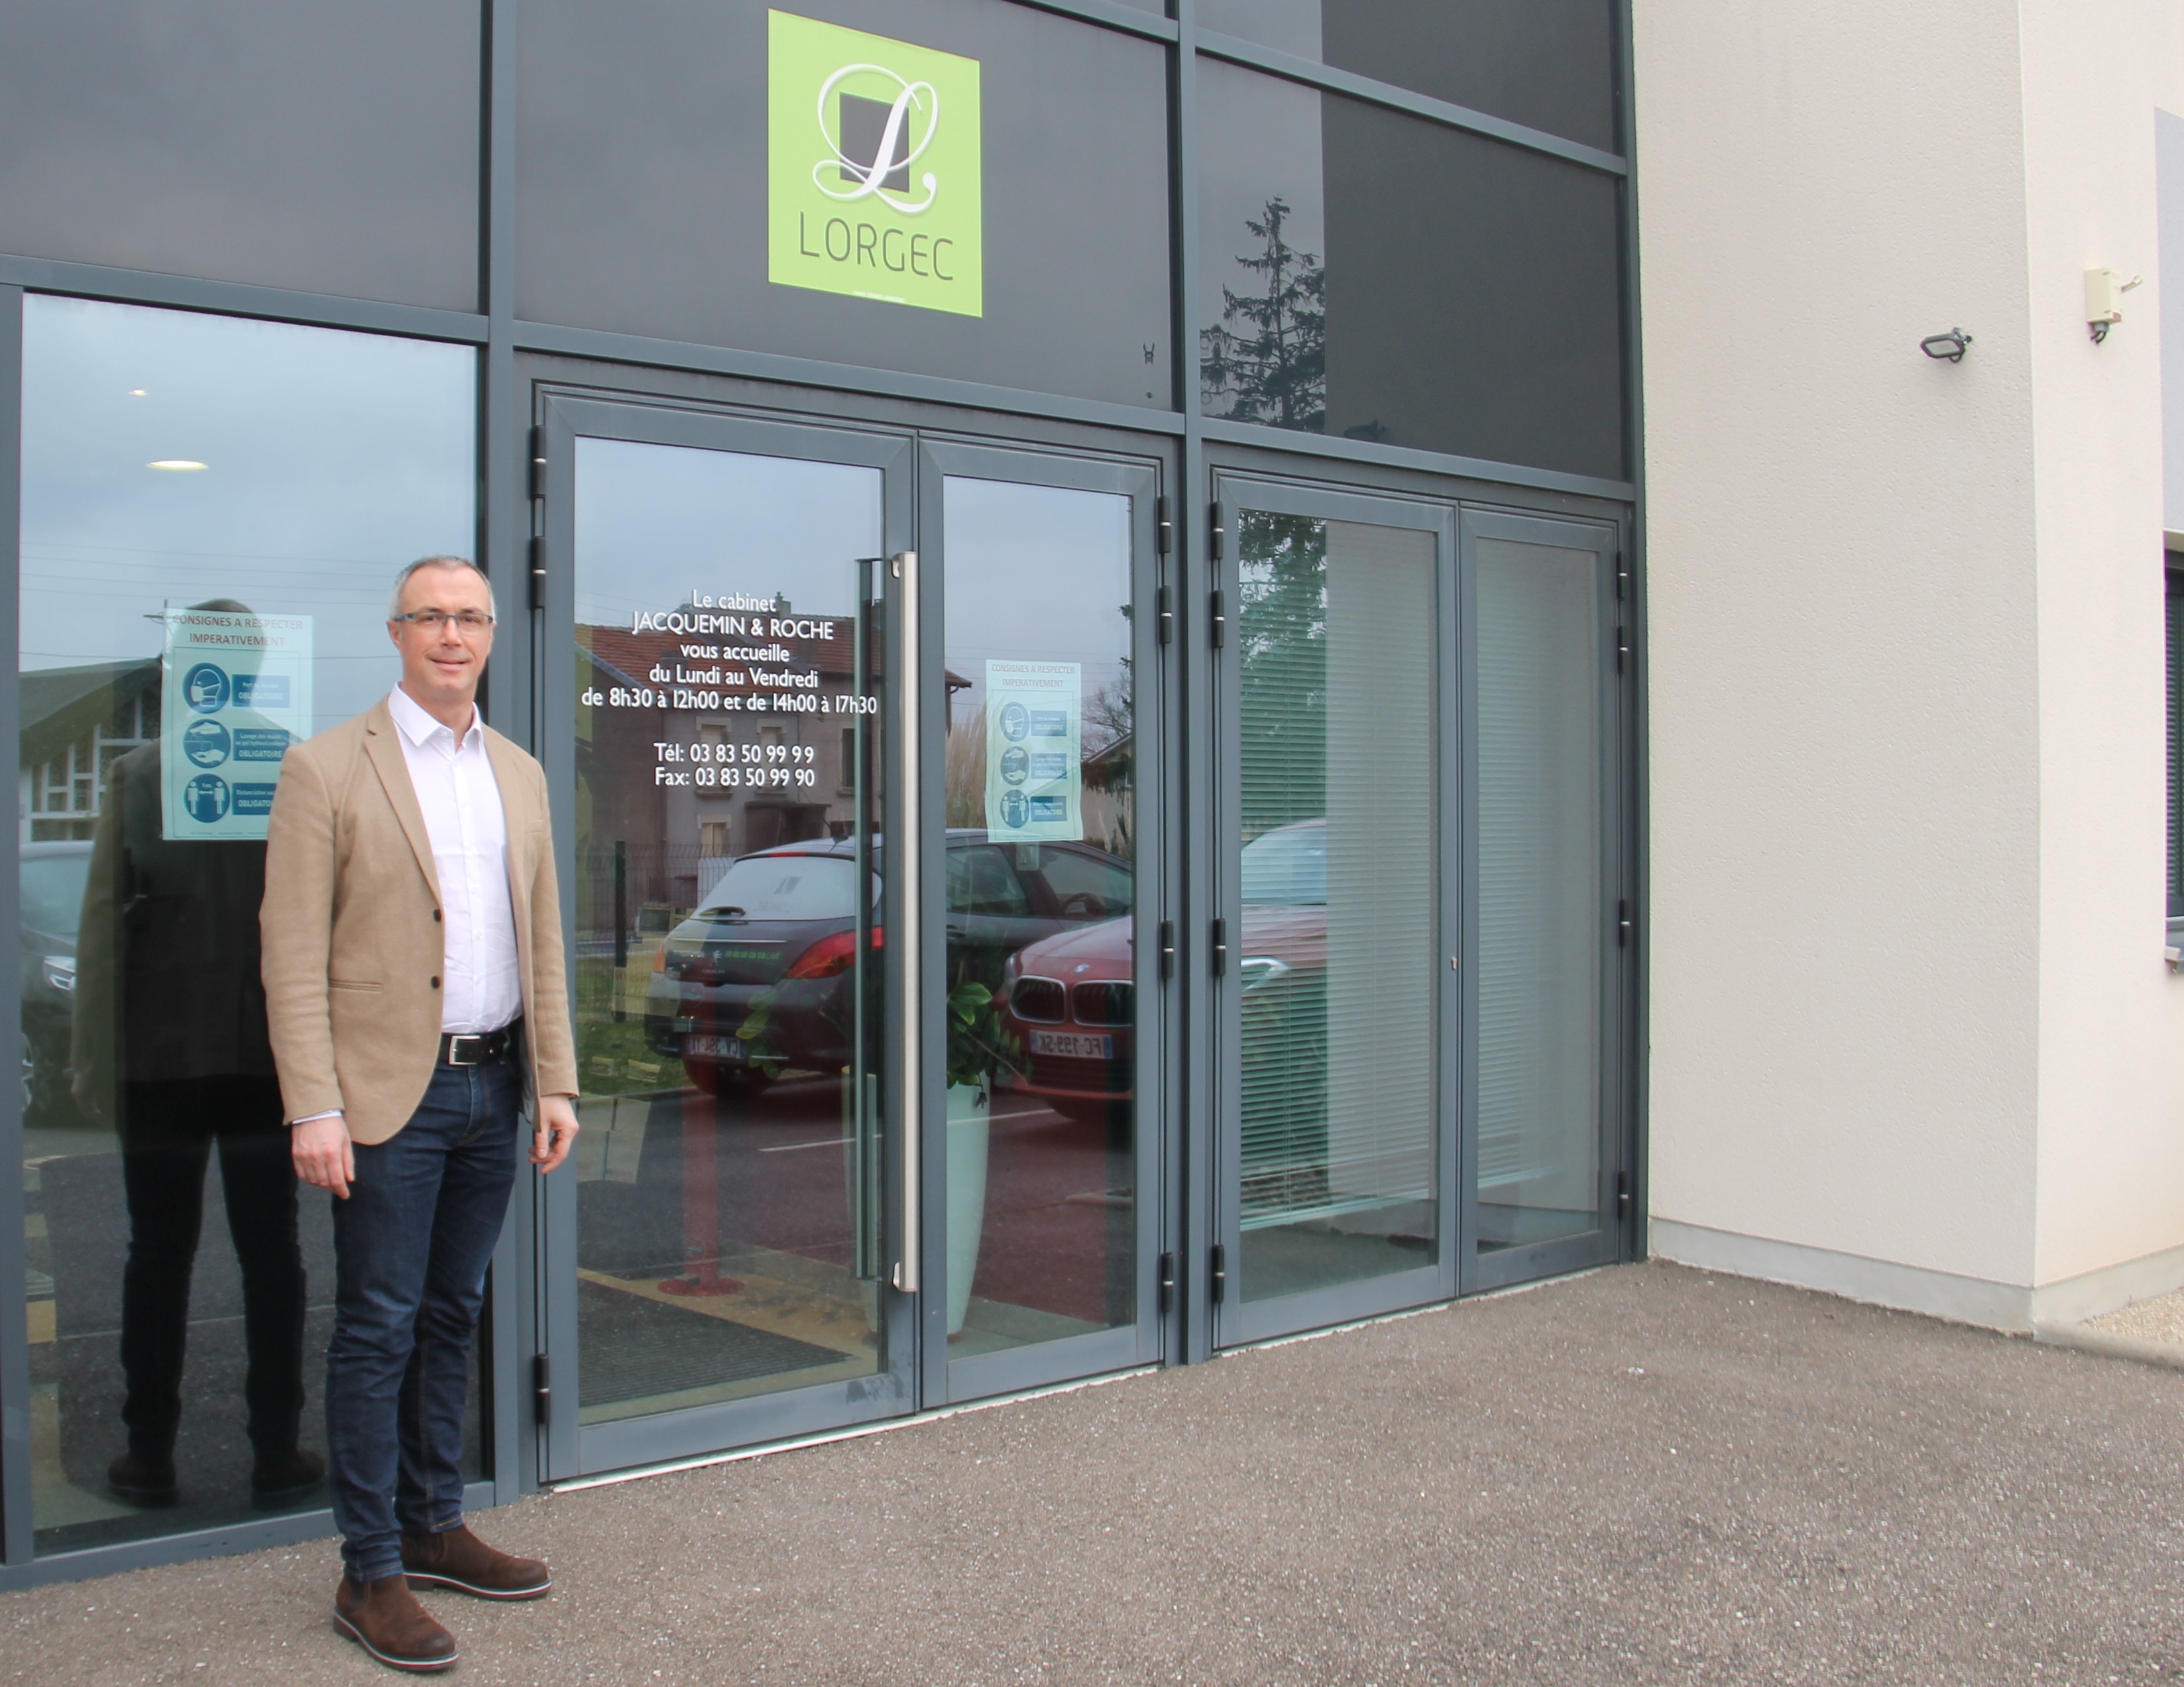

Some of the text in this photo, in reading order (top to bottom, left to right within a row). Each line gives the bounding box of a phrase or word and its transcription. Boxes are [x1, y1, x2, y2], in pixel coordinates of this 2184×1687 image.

[799, 211, 954, 280] LORGEC
[692, 589, 777, 612] Le cabinet
[173, 614, 303, 629] CONSIGNES A RESPECTER
[632, 611, 834, 640] JACQUEMIN & ROCHE
[190, 633, 285, 646] IMPERATIVEMENT
[680, 643, 790, 662] vous accueille
[649, 664, 819, 688] du Lundi au Vendredi
[992, 664, 1029, 673] CONSIGNES
[1037, 665, 1075, 674] RESPECTER
[1002, 678, 1064, 687] IMPERATIVEMENT
[581, 687, 878, 715] de 8h30 à 12h00 et de 14h00 à 17h30
[653, 742, 685, 762] Tél:
[689, 743, 710, 762] 03
[715, 744, 736, 763] 83
[740, 744, 762, 763] 50
[766, 745, 787, 764] 99
[654, 766, 815, 787] Fax: 03 83 50 99 90
